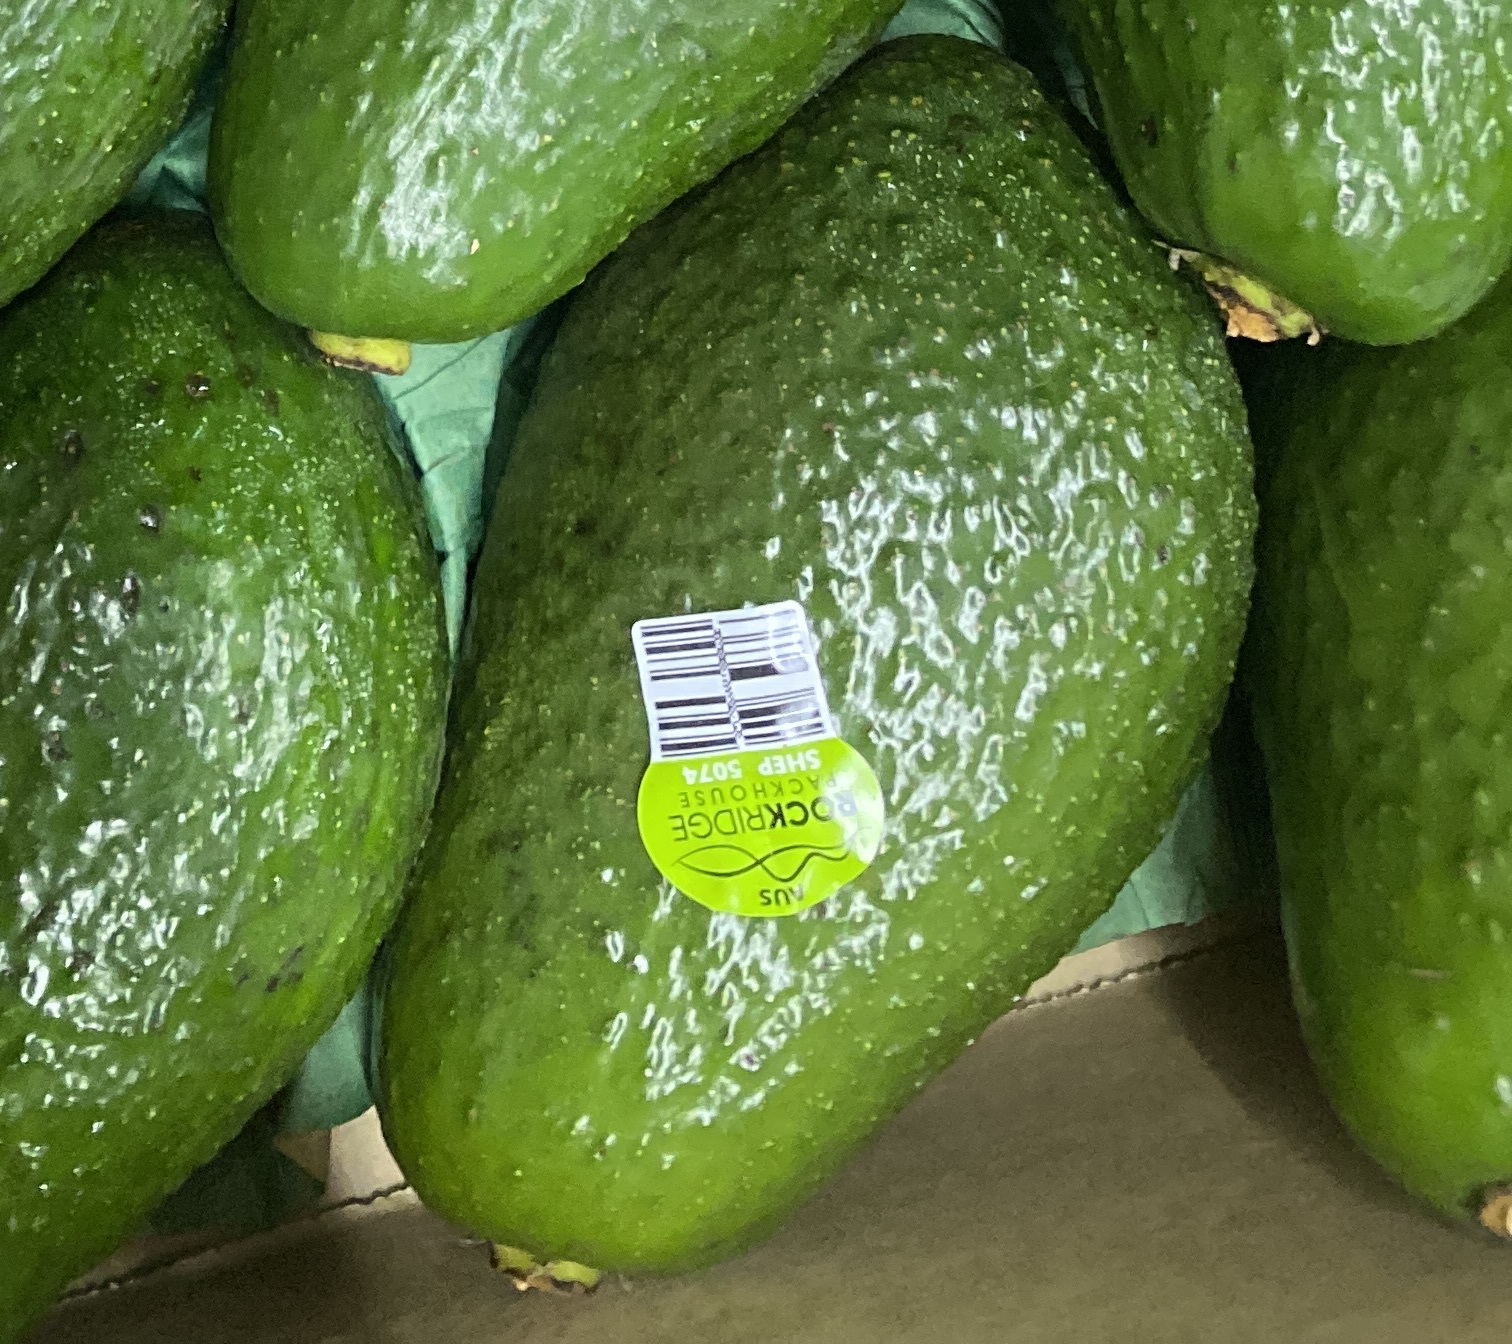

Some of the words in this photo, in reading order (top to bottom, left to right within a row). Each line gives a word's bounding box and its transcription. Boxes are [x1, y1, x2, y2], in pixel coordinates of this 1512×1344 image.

[681, 759, 742, 785] 5074
[758, 748, 821, 775] SHEP
[668, 790, 857, 842] ROCKRIDGE
[759, 885, 804, 905] AUS
